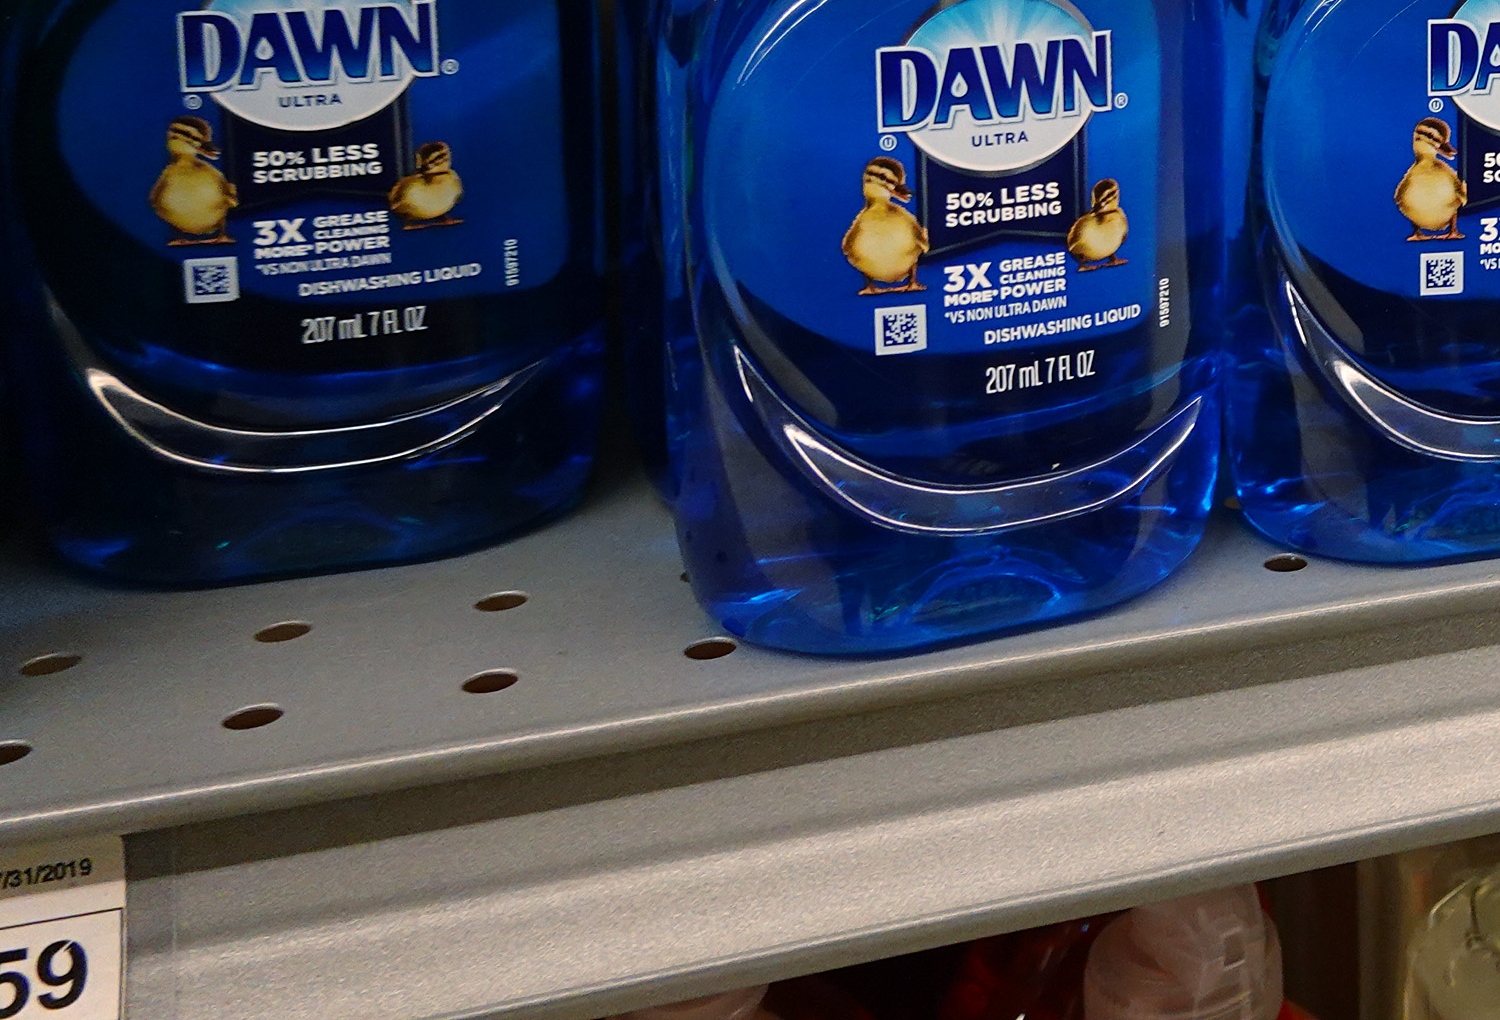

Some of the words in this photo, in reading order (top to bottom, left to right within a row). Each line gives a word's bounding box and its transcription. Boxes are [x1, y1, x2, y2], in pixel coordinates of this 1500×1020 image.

[876, 30, 1112, 133] DAWN
[278, 93, 343, 108] ULTRA
[971, 130, 1029, 148] ULTRA
[253, 150, 306, 168] 50%
[312, 142, 380, 164] LESS
[252, 161, 383, 184] SCRUBBING
[945, 191, 994, 211] 50%
[1001, 182, 1061, 205] LESS
[312, 210, 390, 228] GREASE
[945, 200, 1062, 228] SCRUBBING
[252, 217, 307, 246] 3X
[312, 224, 390, 240] CLEANING
[314, 235, 390, 254] POWER
[999, 252, 1066, 273] GREASE
[999, 266, 1067, 285] CLEANING
[298, 271, 422, 297] DISHWASHING
[423, 263, 483, 283] LIQUID
[943, 261, 993, 293] 3X
[999, 278, 1067, 300] POWER
[966, 306, 994, 321] NON
[994, 300, 1032, 319] ULTRA
[1032, 295, 1068, 314] DAWN
[301, 316, 337, 345] 207
[337, 313, 367, 340] mL
[367, 311, 381, 336] 7
[382, 308, 403, 334] FL
[403, 305, 428, 331] OZ
[984, 313, 1092, 345] DISHWASHING
[1095, 303, 1142, 327] LIQUID
[985, 362, 1016, 394] 207
[1018, 359, 1044, 389] mL
[1044, 357, 1056, 385] 7
[1057, 354, 1074, 381] FL
[1076, 349, 1097, 378] OZ
